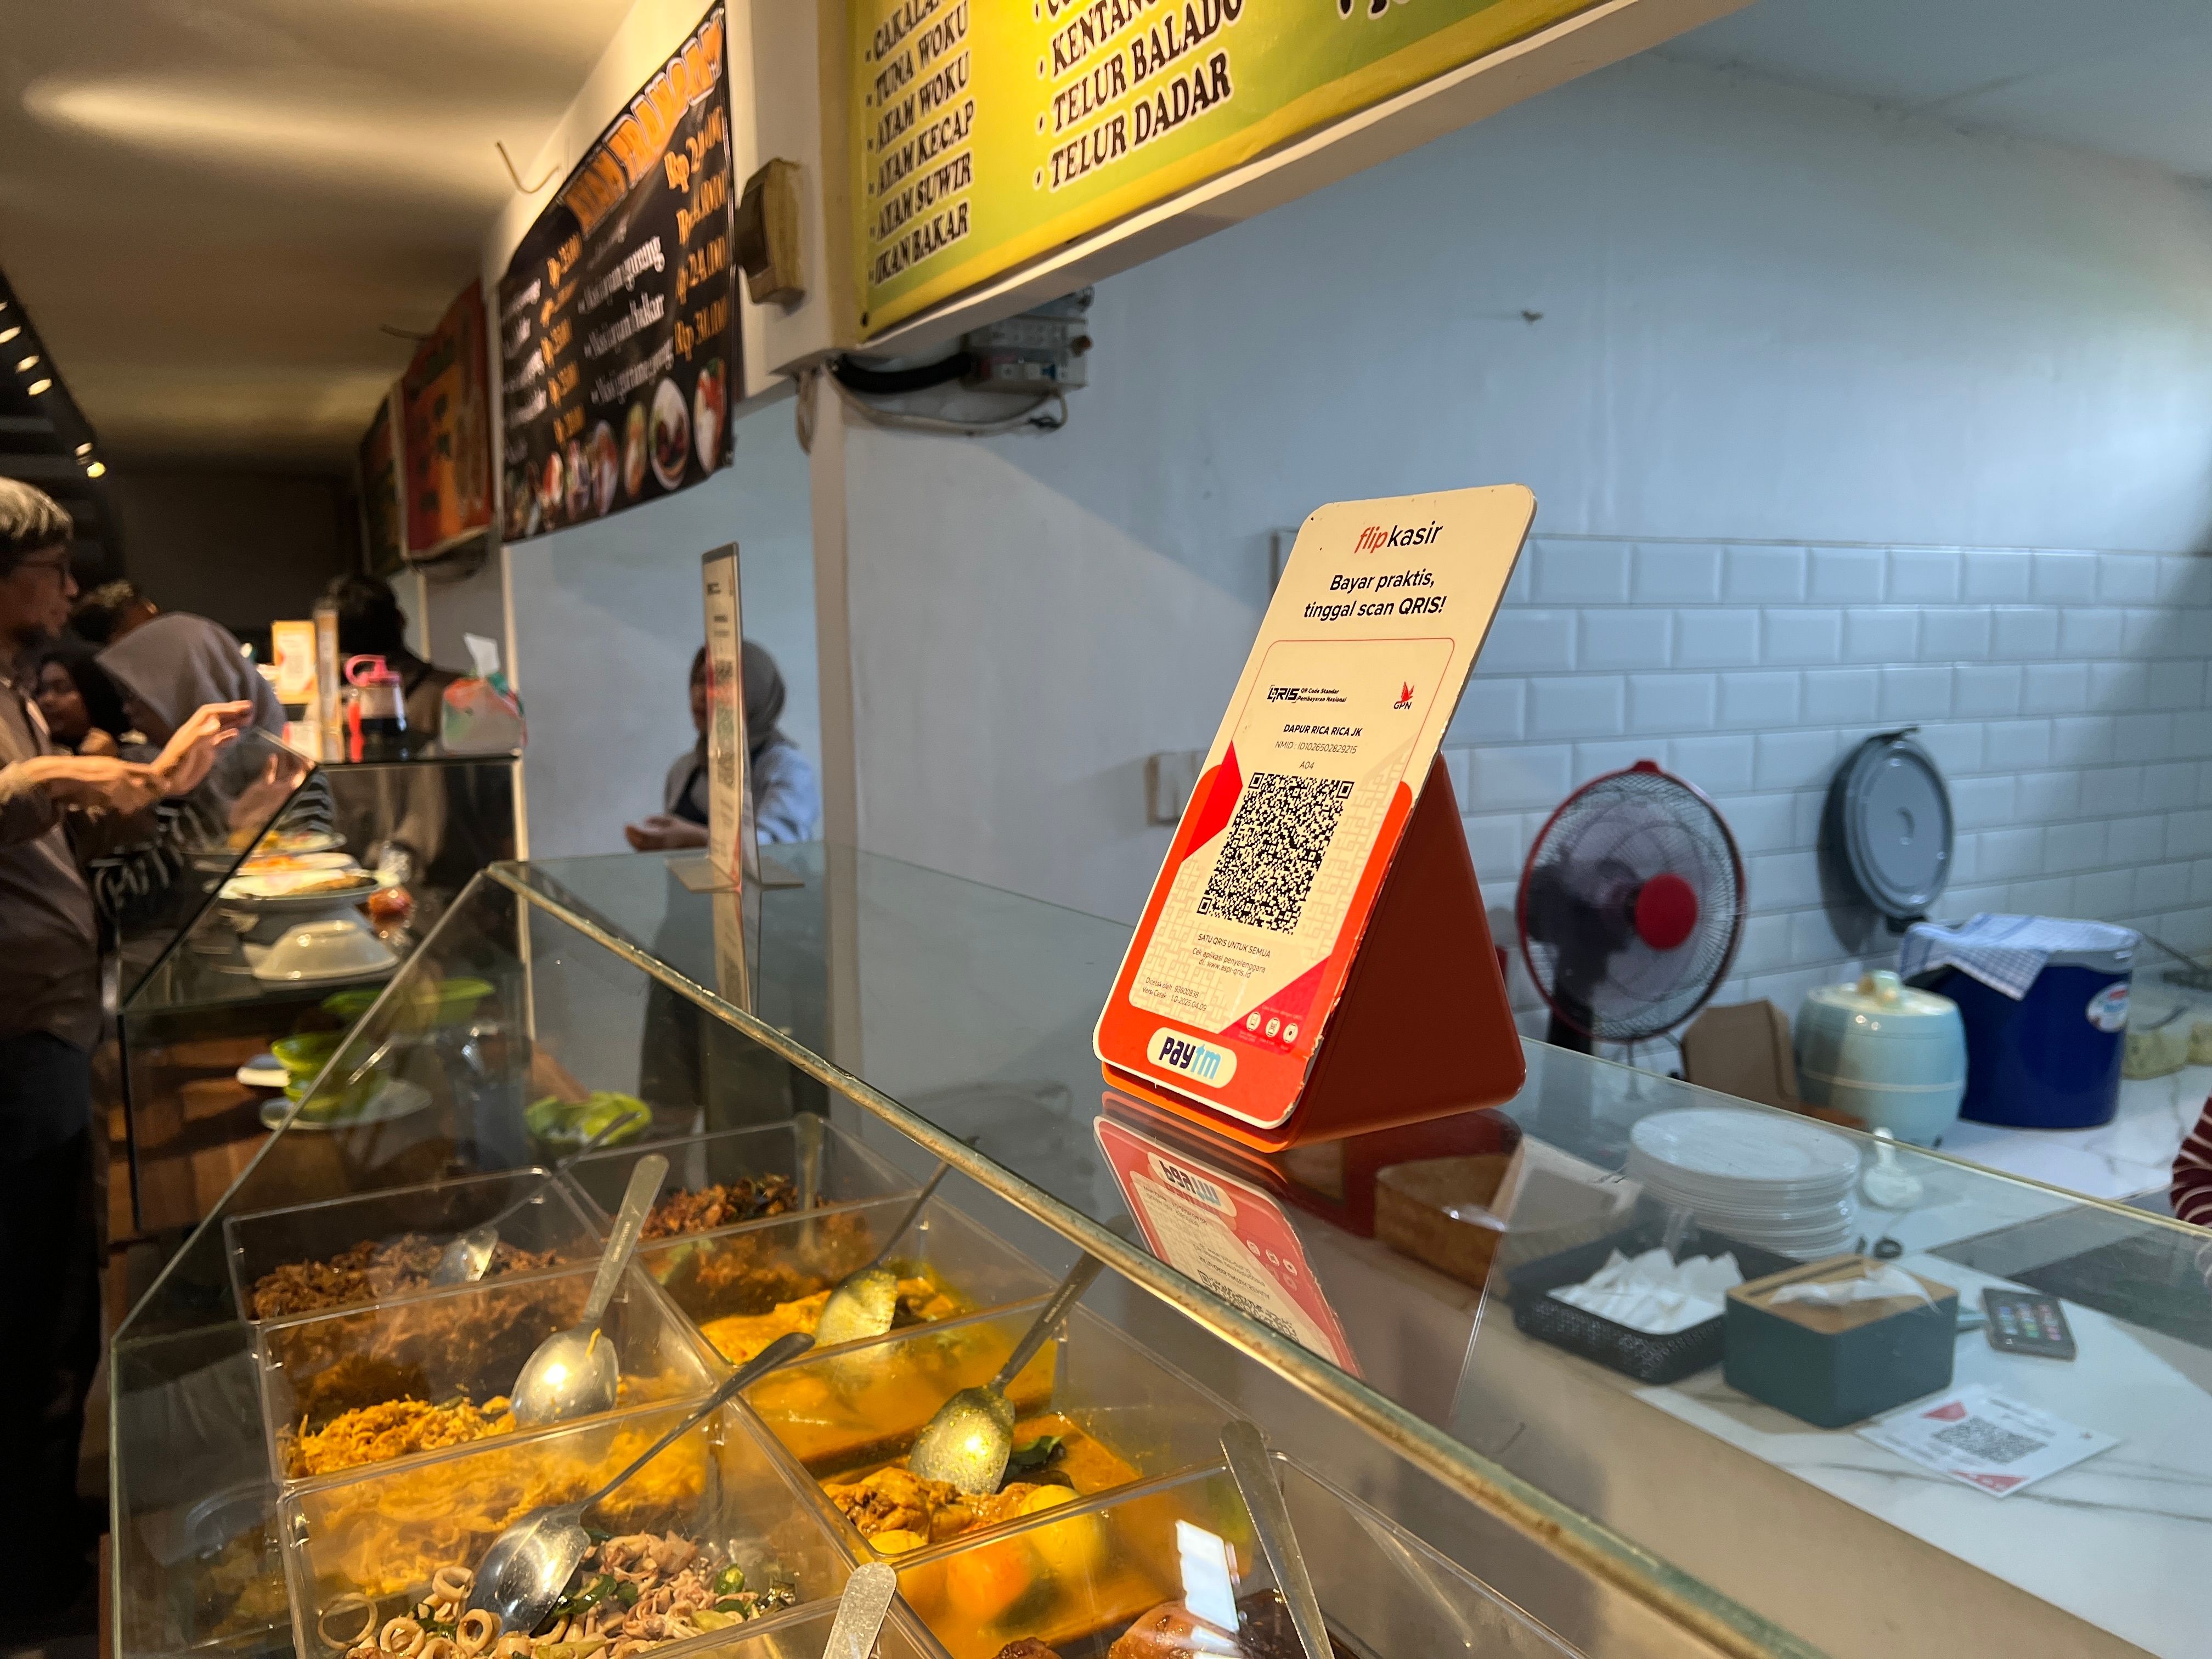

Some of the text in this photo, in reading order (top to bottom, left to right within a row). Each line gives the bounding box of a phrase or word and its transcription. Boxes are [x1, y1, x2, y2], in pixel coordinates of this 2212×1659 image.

[876, 0, 968, 106] TUNA WOKU
[1052, 0, 1154, 77] KENTAN
[1053, 0, 1242, 132] TELUR BALADO
[878, 50, 969, 148] AYAM WOKU
[1051, 52, 1231, 188] TELUR DADAR
[878, 99, 973, 196] AYAM KECAP
[664, 152, 690, 193] Rp
[879, 152, 970, 241] AYAM SUWIR
[874, 202, 967, 284] IKAN BAKAR
[675, 320, 694, 361] Rp
[1354, 520, 1443, 554] flipkasir
[1330, 568, 1435, 594] Bayar praktis,
[1304, 596, 1447, 621] tinggal scan QRIS!
[1267, 687, 1300, 702] QRIS
[1393, 701, 1412, 709] GPN
[1283, 724, 1363, 736] DAPUR RICA RICA JK
[1275, 741, 1294, 749] NMID
[1297, 743, 1358, 754] ID1026502829215
[1299, 761, 1314, 769] A04
[1192, 947, 1266, 973] Cek aplikasi penyelenggara
[1198, 933, 1271, 958] SATU QRIS UNTUK SEMUA
[1143, 986, 1154, 995] Versi
[1154, 989, 1167, 999] Cetak
[1146, 977, 1162, 987] Dicetak
[1174, 985, 1199, 998] 93600838
